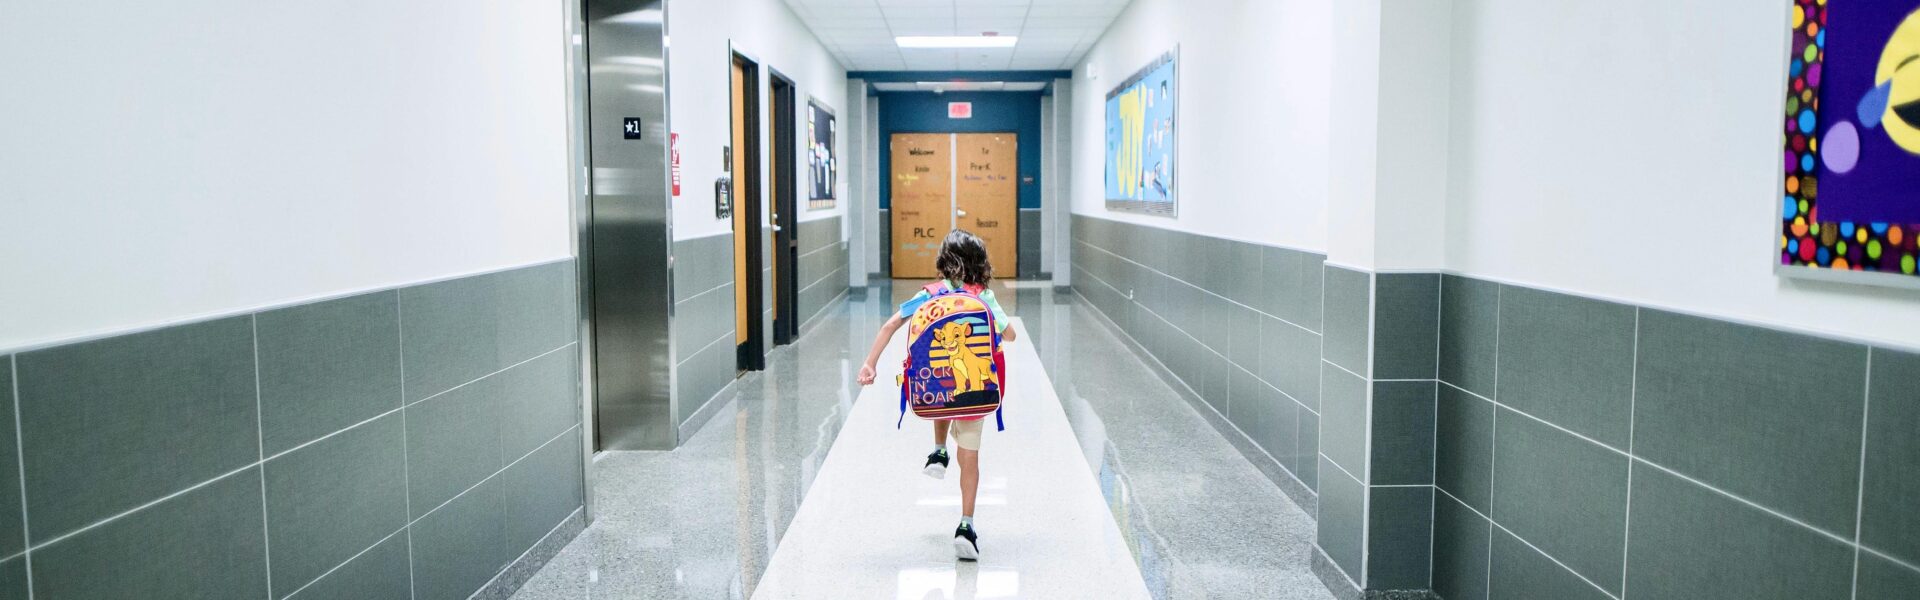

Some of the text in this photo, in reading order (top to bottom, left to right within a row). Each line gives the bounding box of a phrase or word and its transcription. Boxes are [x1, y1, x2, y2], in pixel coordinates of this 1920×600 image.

[633, 121, 640, 133] 1
[1117, 83, 1147, 198] JOY
[970, 162, 991, 171] Pre-K
[914, 227, 935, 238] PLC
[914, 367, 951, 379] OCK
[912, 391, 955, 405] ROAR
